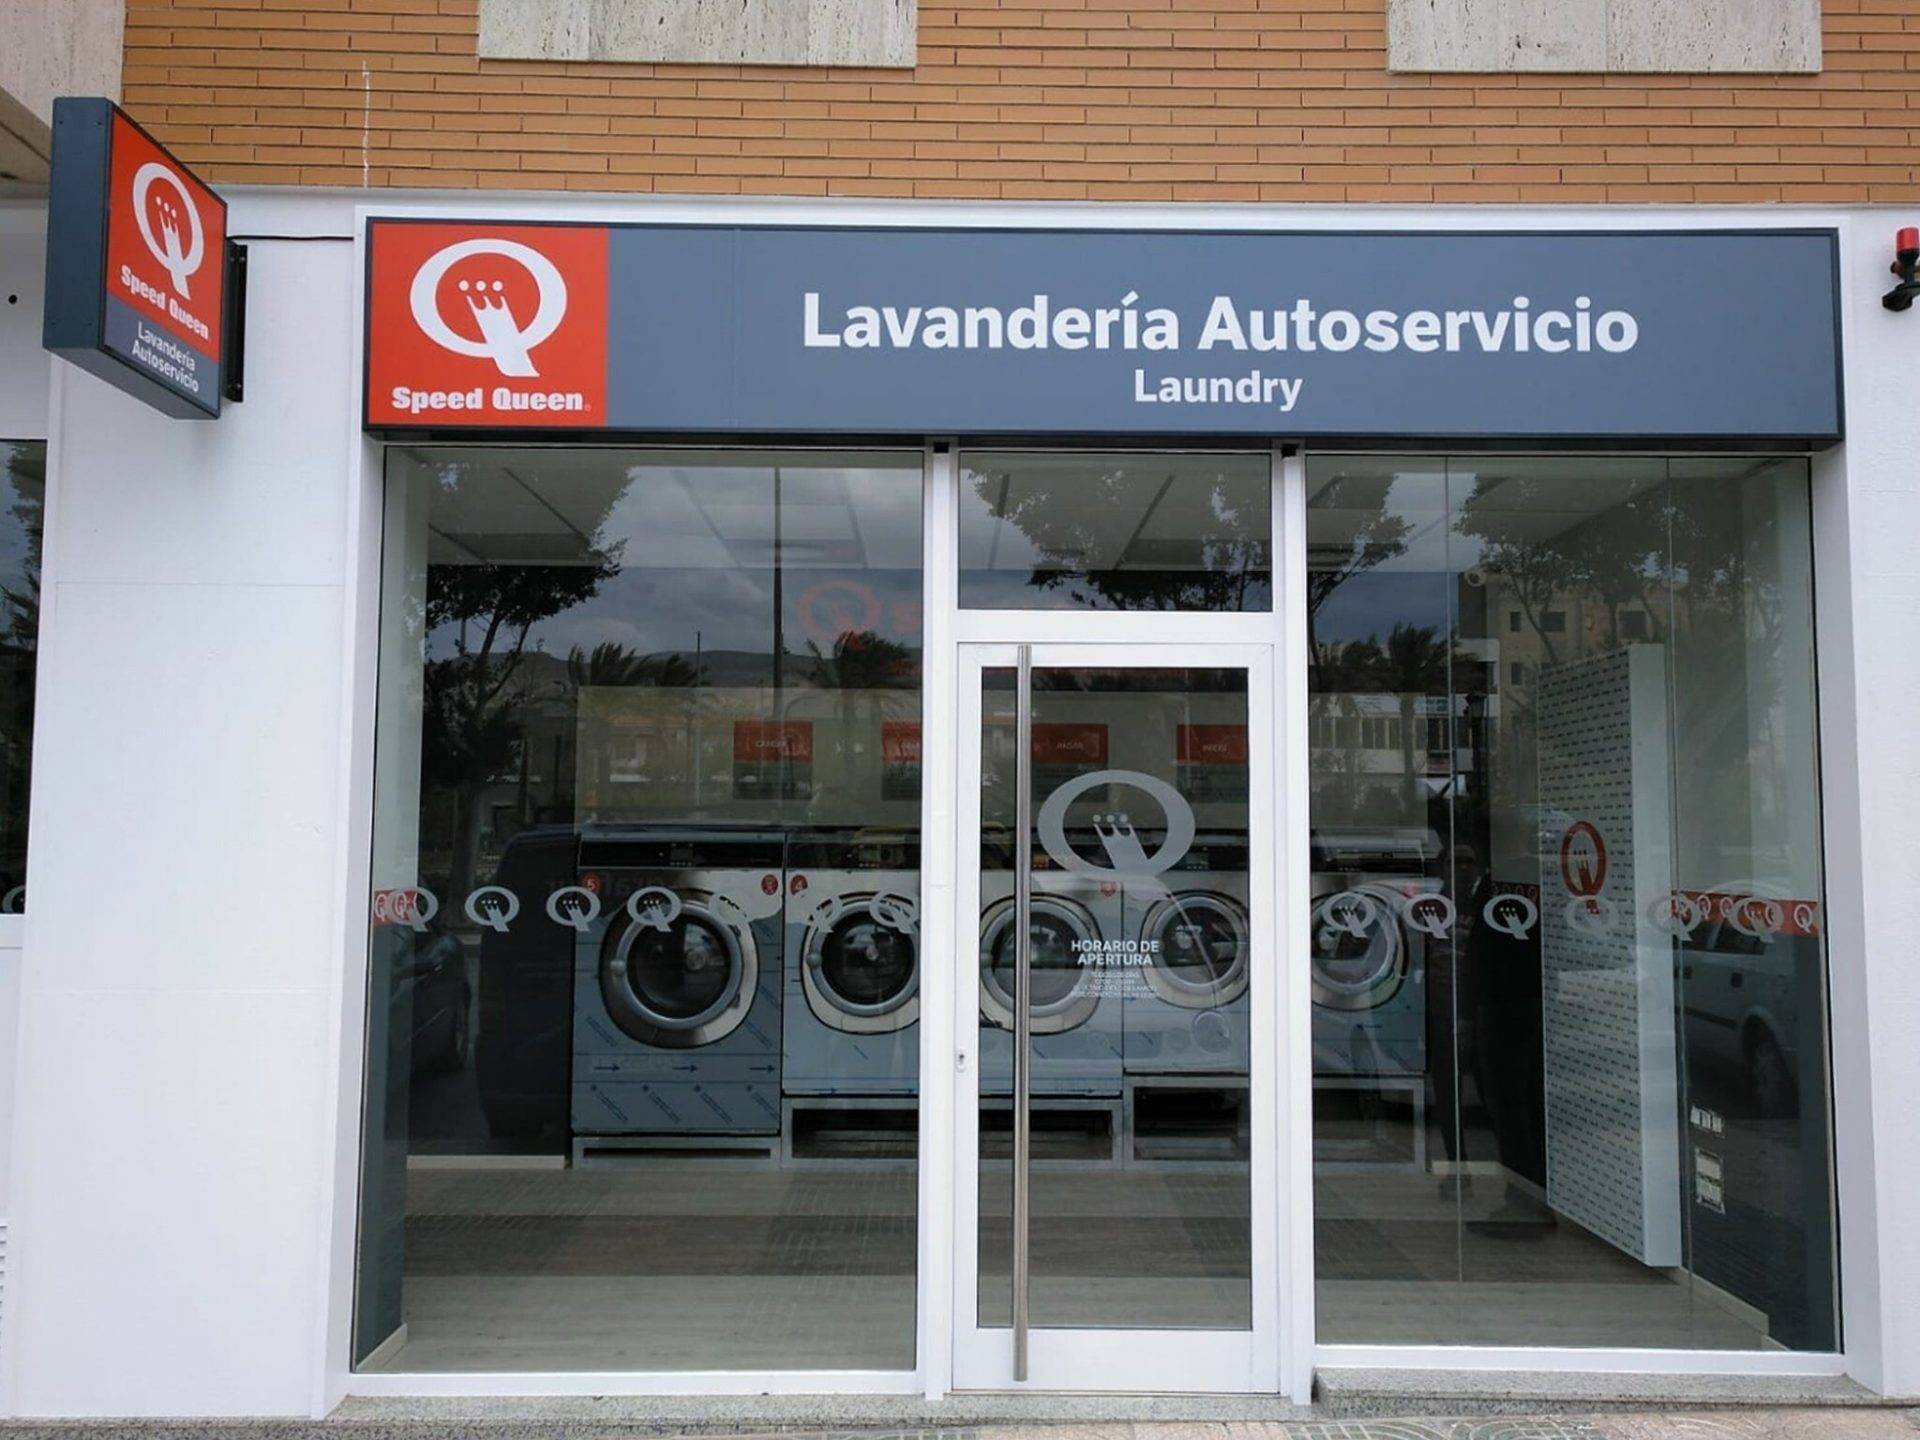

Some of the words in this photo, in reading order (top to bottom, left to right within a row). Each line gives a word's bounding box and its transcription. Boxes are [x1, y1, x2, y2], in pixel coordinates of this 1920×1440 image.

[121, 264, 166, 310] Speed
[169, 298, 209, 340] Queen
[804, 290, 1179, 351] Lavandería
[1197, 296, 1638, 353] Autoservicio
[132, 340, 199, 392] Autoservicio
[392, 387, 483, 414] Speed
[491, 387, 584, 411] Queen
[1135, 369, 1303, 412] Laundry
[1071, 939, 1137, 952] HORARIO
[1140, 939, 1160, 952] DE
[1077, 953, 1153, 966] APERTURA
